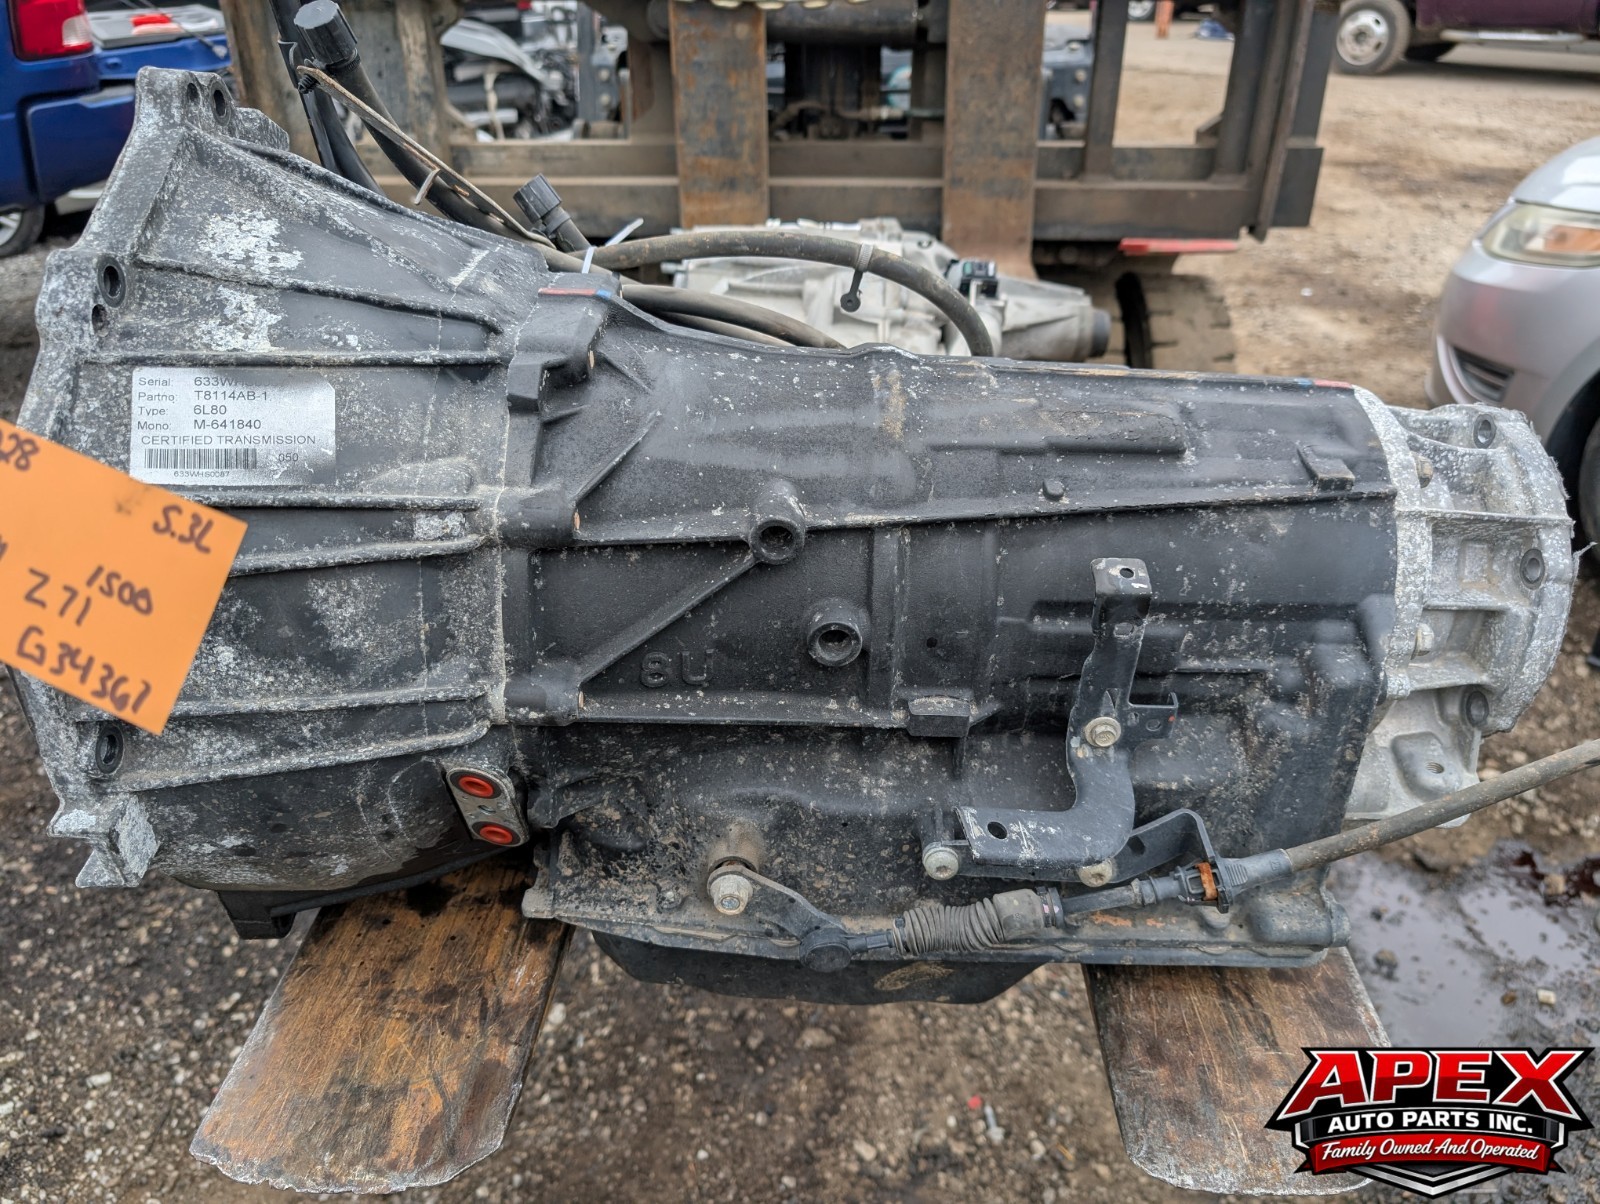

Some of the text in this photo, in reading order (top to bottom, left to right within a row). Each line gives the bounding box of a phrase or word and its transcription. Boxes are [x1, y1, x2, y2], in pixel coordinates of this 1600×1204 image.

[138, 377, 173, 387] Serial:
[138, 392, 178, 402] Partno:
[138, 404, 227, 416] Type: 6L80
[137, 419, 262, 431] Mono: M-641840
[141, 435, 316, 446] CERTIFIED TRANSMISSION
